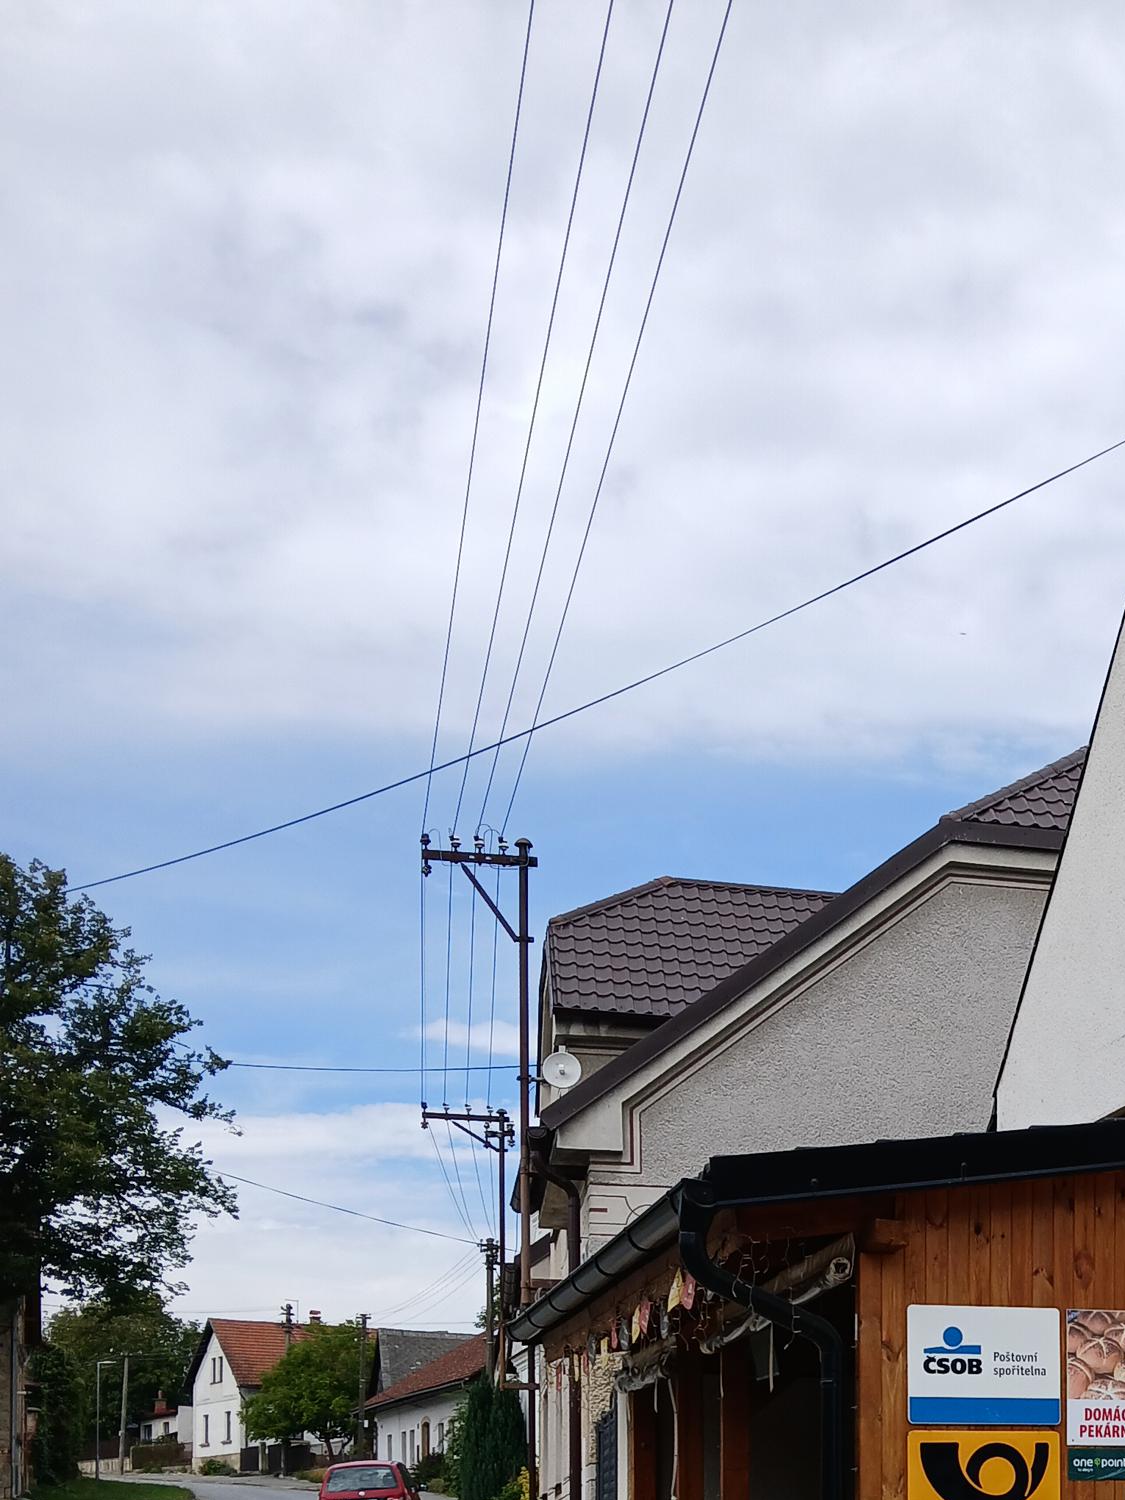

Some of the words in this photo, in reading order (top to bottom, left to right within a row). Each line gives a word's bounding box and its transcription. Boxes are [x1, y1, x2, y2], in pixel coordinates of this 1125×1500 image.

[993, 1351, 1038, 1363] Poštovní
[923, 1355, 983, 1375] ČSOB
[993, 1365, 1047, 1378] spořitelna
[1072, 1458, 1094, 1467] one
